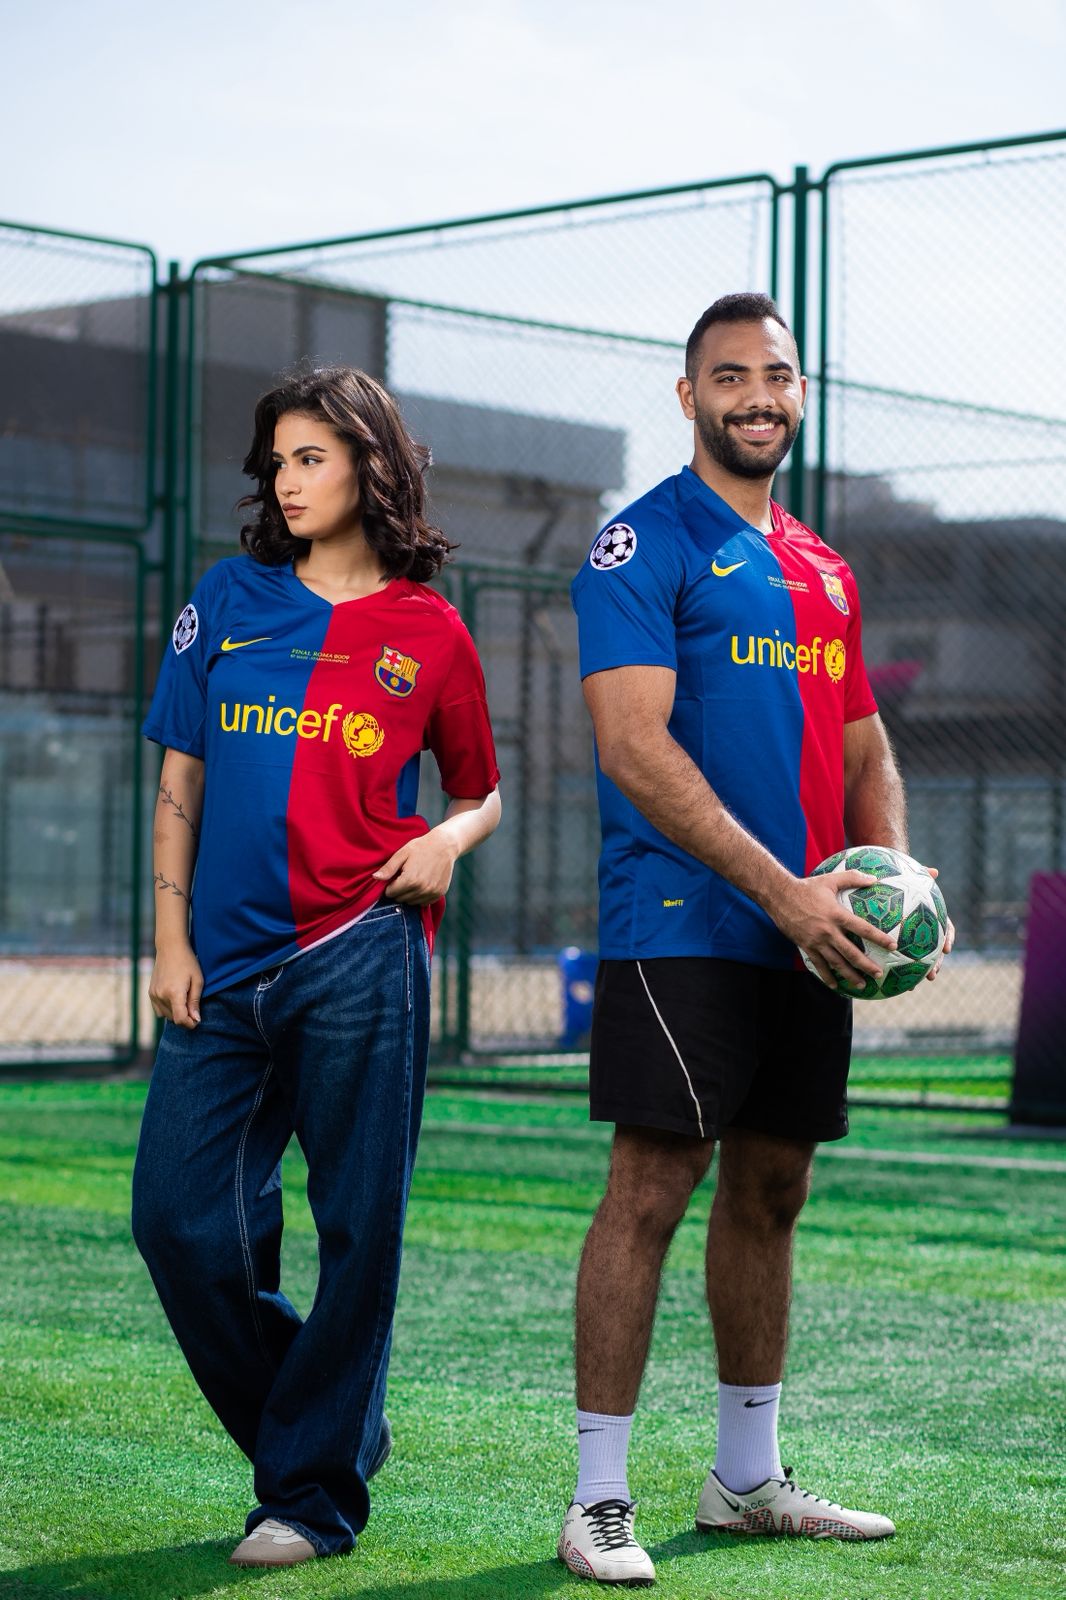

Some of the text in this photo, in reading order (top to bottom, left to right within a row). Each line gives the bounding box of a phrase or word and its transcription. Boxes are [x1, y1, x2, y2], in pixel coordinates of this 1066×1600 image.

[291, 648, 312, 656] FINAL
[312, 651, 333, 659] ROMA
[731, 629, 822, 676] unicef
[220, 695, 343, 743] unicef
